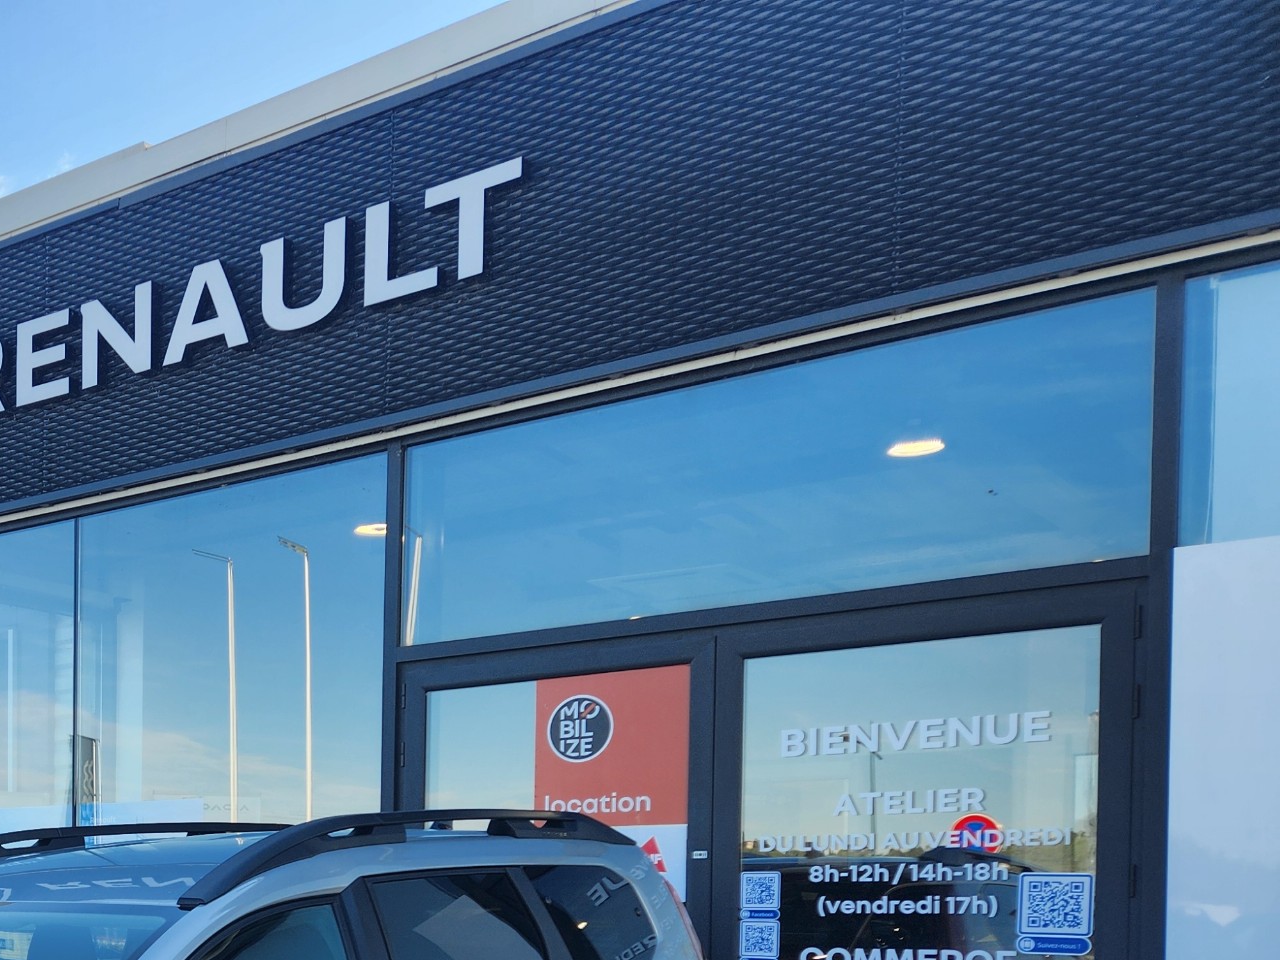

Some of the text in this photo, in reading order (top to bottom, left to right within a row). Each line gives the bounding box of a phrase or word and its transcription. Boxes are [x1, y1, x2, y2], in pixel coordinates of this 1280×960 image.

[780, 710, 1052, 758] BIENVENUE
[544, 792, 651, 814] location
[833, 787, 985, 816] ATELIER
[758, 827, 1072, 853] DU LUNDI AU VENDREDI
[818, 894, 999, 917] (vendredi 17h)
